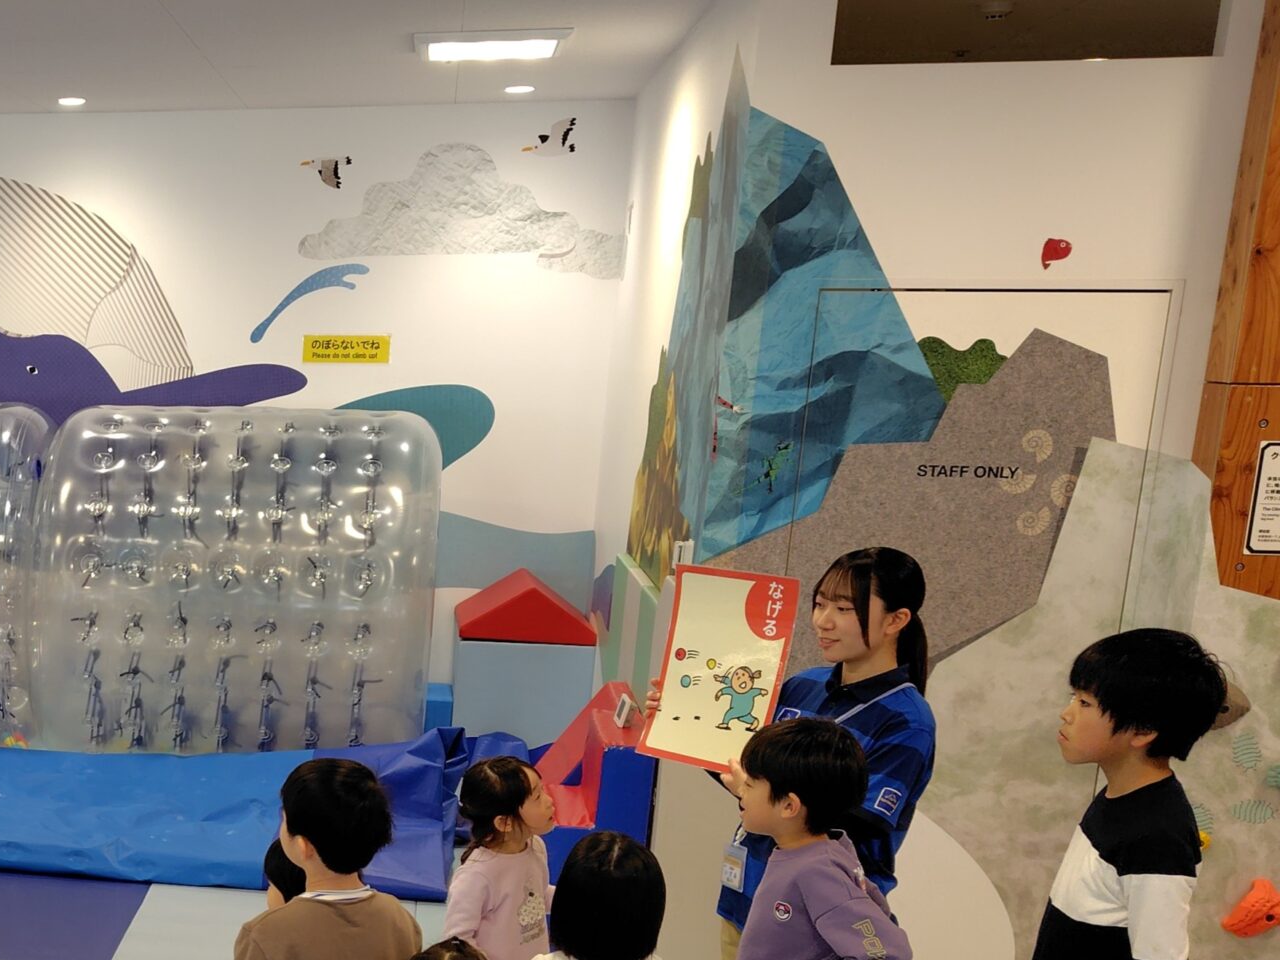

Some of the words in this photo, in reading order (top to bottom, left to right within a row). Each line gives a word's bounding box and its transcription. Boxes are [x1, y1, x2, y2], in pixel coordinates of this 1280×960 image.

[311, 339, 381, 350] のぼらないでね
[312, 351, 331, 359] Please
[917, 464, 970, 478] STAFF
[974, 465, 1020, 479] ONLY
[763, 581, 784, 637] なげる
